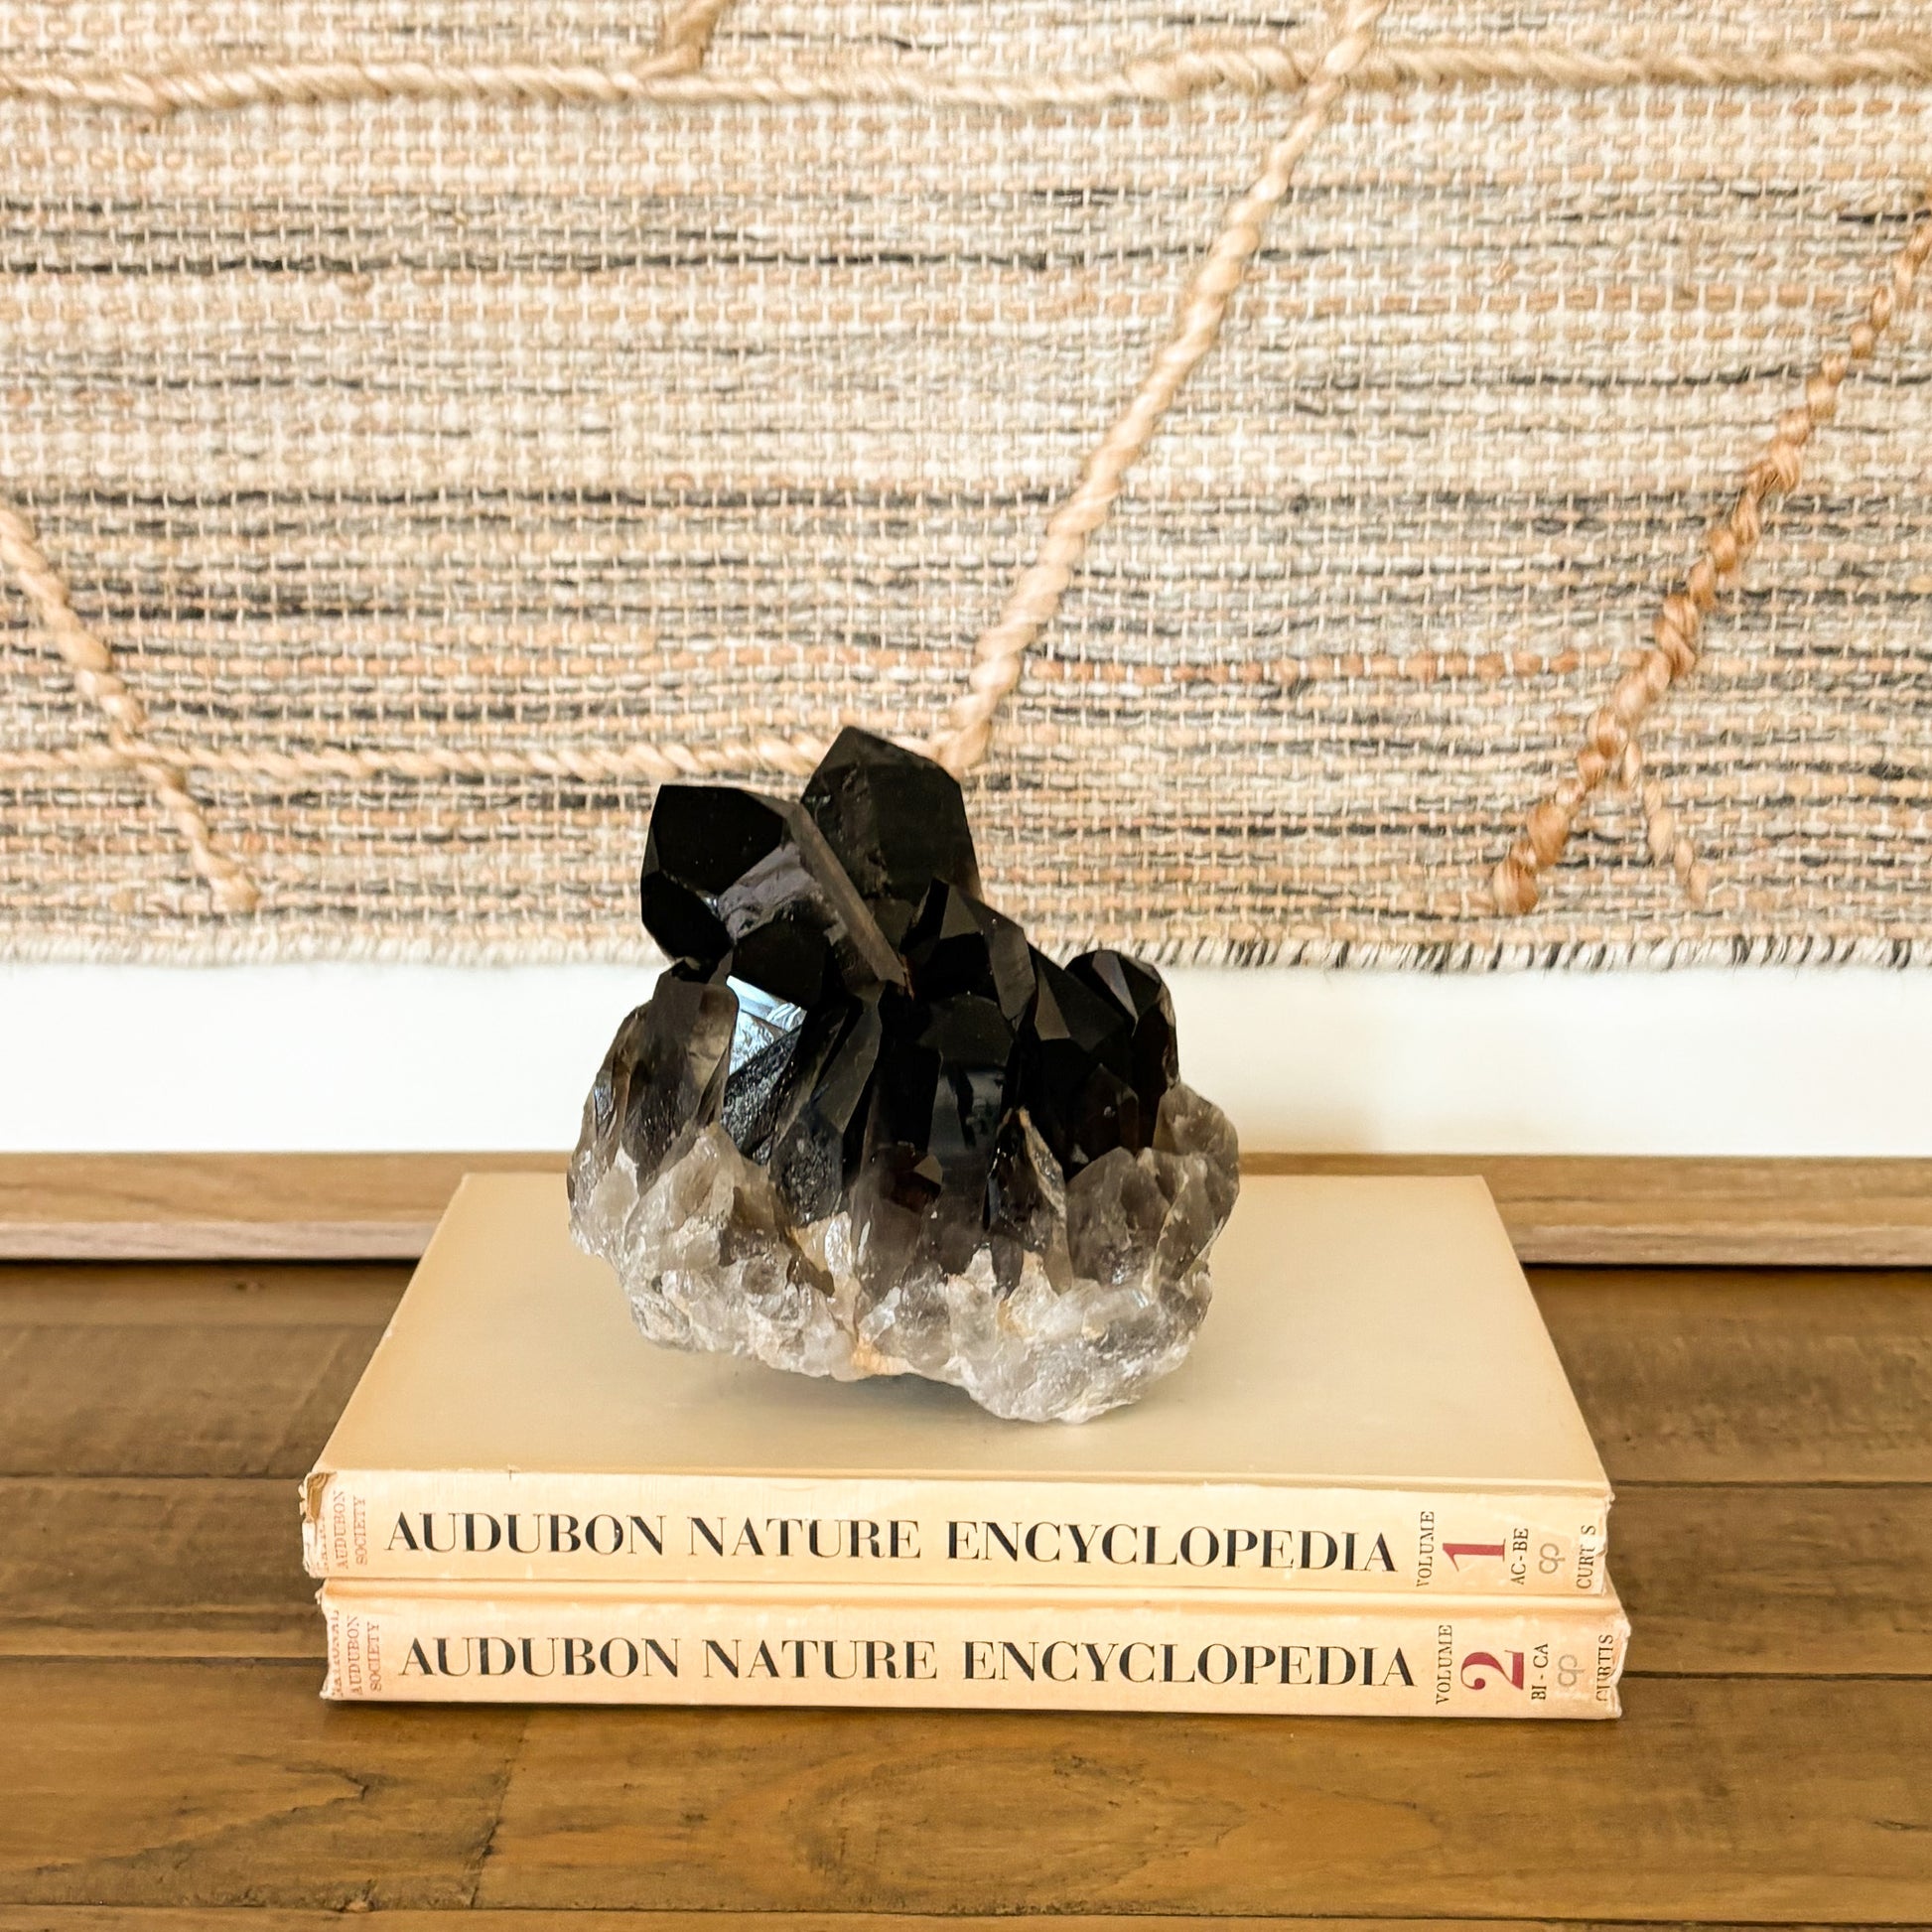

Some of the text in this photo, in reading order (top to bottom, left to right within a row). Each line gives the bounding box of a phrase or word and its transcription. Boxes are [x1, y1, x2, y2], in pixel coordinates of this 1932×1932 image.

[333, 1490, 348, 1570] AUDUBON
[352, 1495, 367, 1566] SOCIETY
[387, 1511, 1398, 1573] AUDUBON NATURE ENCYCLOPEDIA
[1416, 1510, 1435, 1587] VOLUME
[1442, 1538, 1507, 1573] 1
[1577, 1524, 1596, 1589] CURTS
[346, 1615, 363, 1696] AUDUBON
[366, 1621, 382, 1692] SOCIETY
[399, 1636, 1418, 1688] AUDUBON NATURE ENCYCLOPEDIA
[1436, 1624, 1452, 1705] VOLUME
[1460, 1649, 1524, 1691] 2
